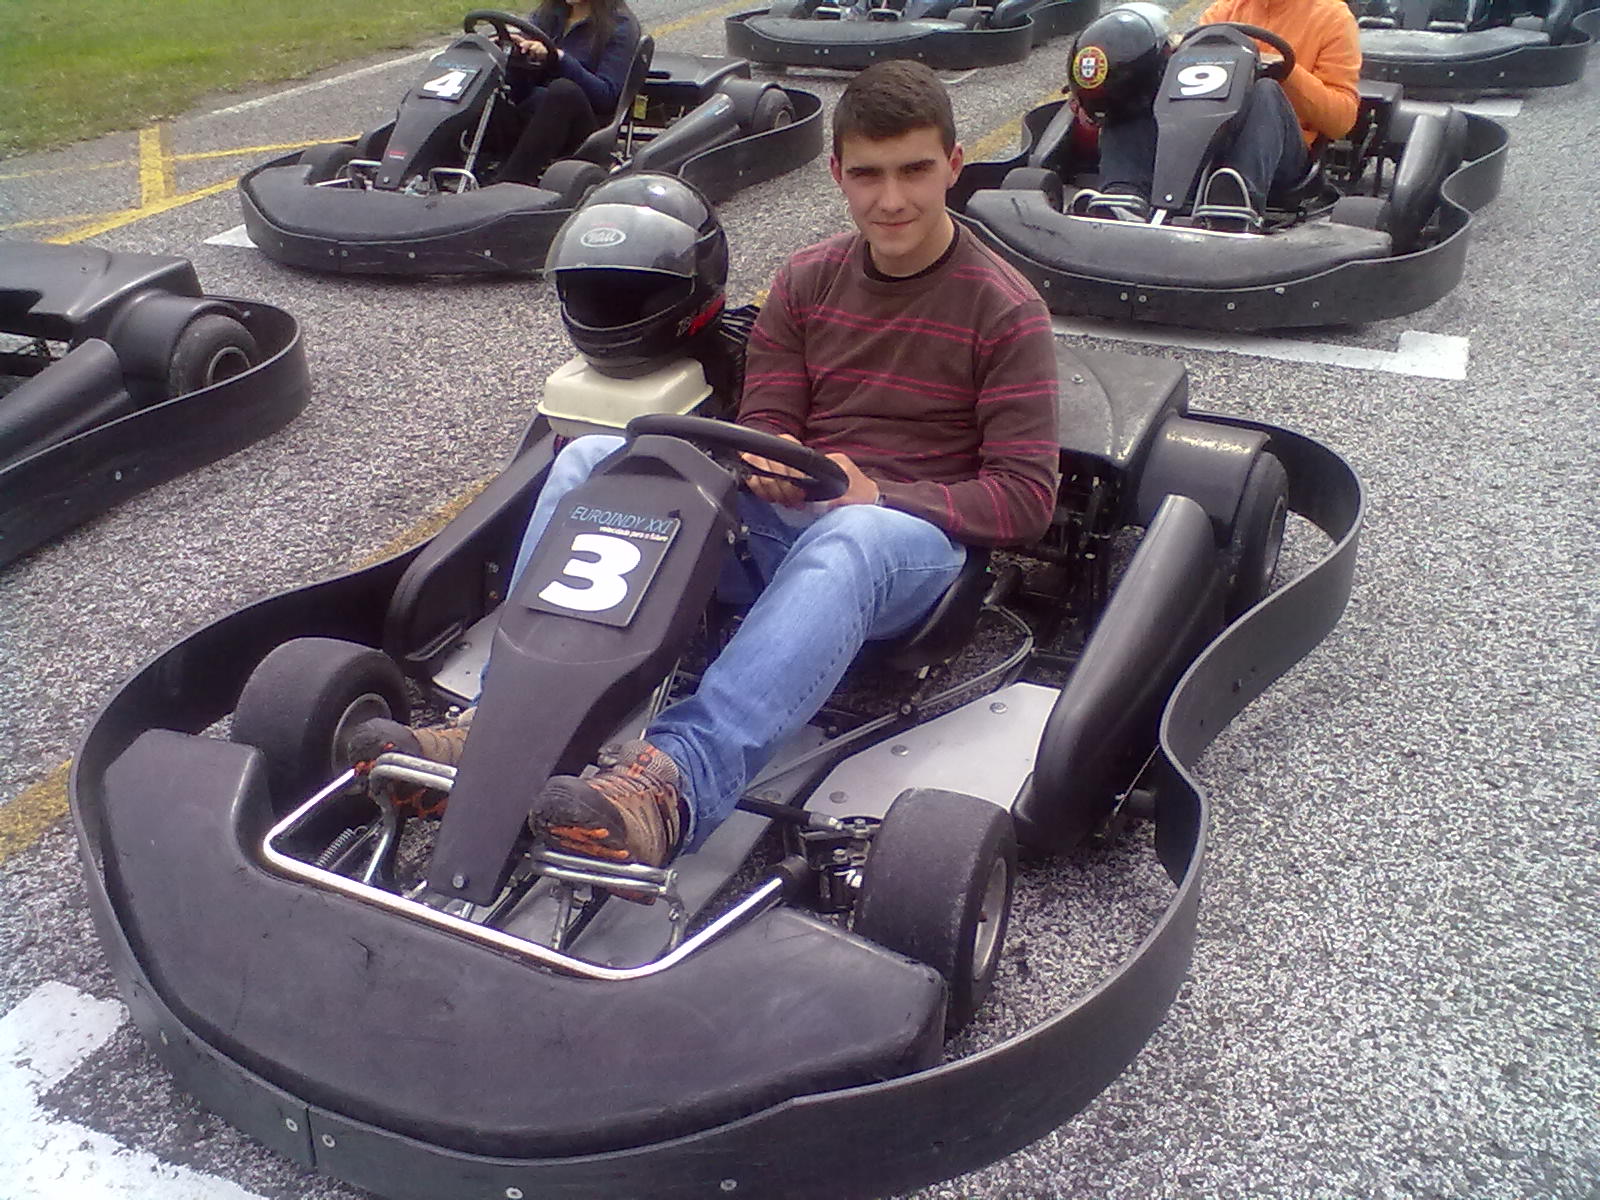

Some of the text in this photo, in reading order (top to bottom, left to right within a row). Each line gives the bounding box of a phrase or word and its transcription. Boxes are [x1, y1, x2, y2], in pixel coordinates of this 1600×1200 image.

[423, 71, 467, 97] 4
[1177, 65, 1228, 96] 9
[571, 506, 645, 529] EUROINDY
[645, 518, 673, 534] XXI
[538, 533, 641, 612] 3
